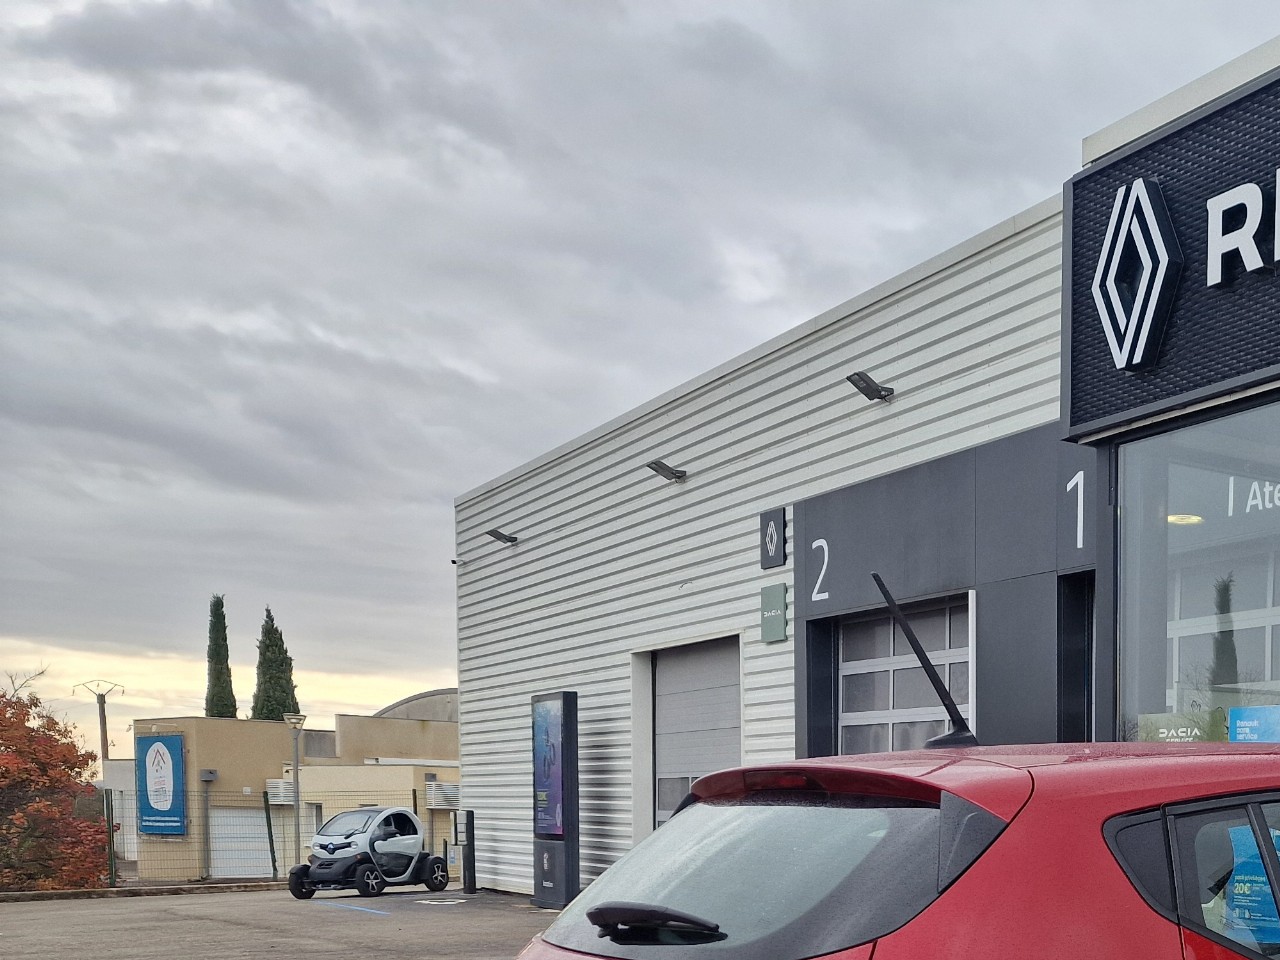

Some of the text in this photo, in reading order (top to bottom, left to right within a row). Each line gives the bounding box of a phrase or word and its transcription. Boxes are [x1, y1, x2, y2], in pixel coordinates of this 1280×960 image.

[1066, 470, 1085, 549] 1
[811, 538, 829, 602] 2
[1236, 719, 1259, 727] Renault
[1159, 728, 1201, 738] DACIA
[1234, 883, 1251, 894] 20€
